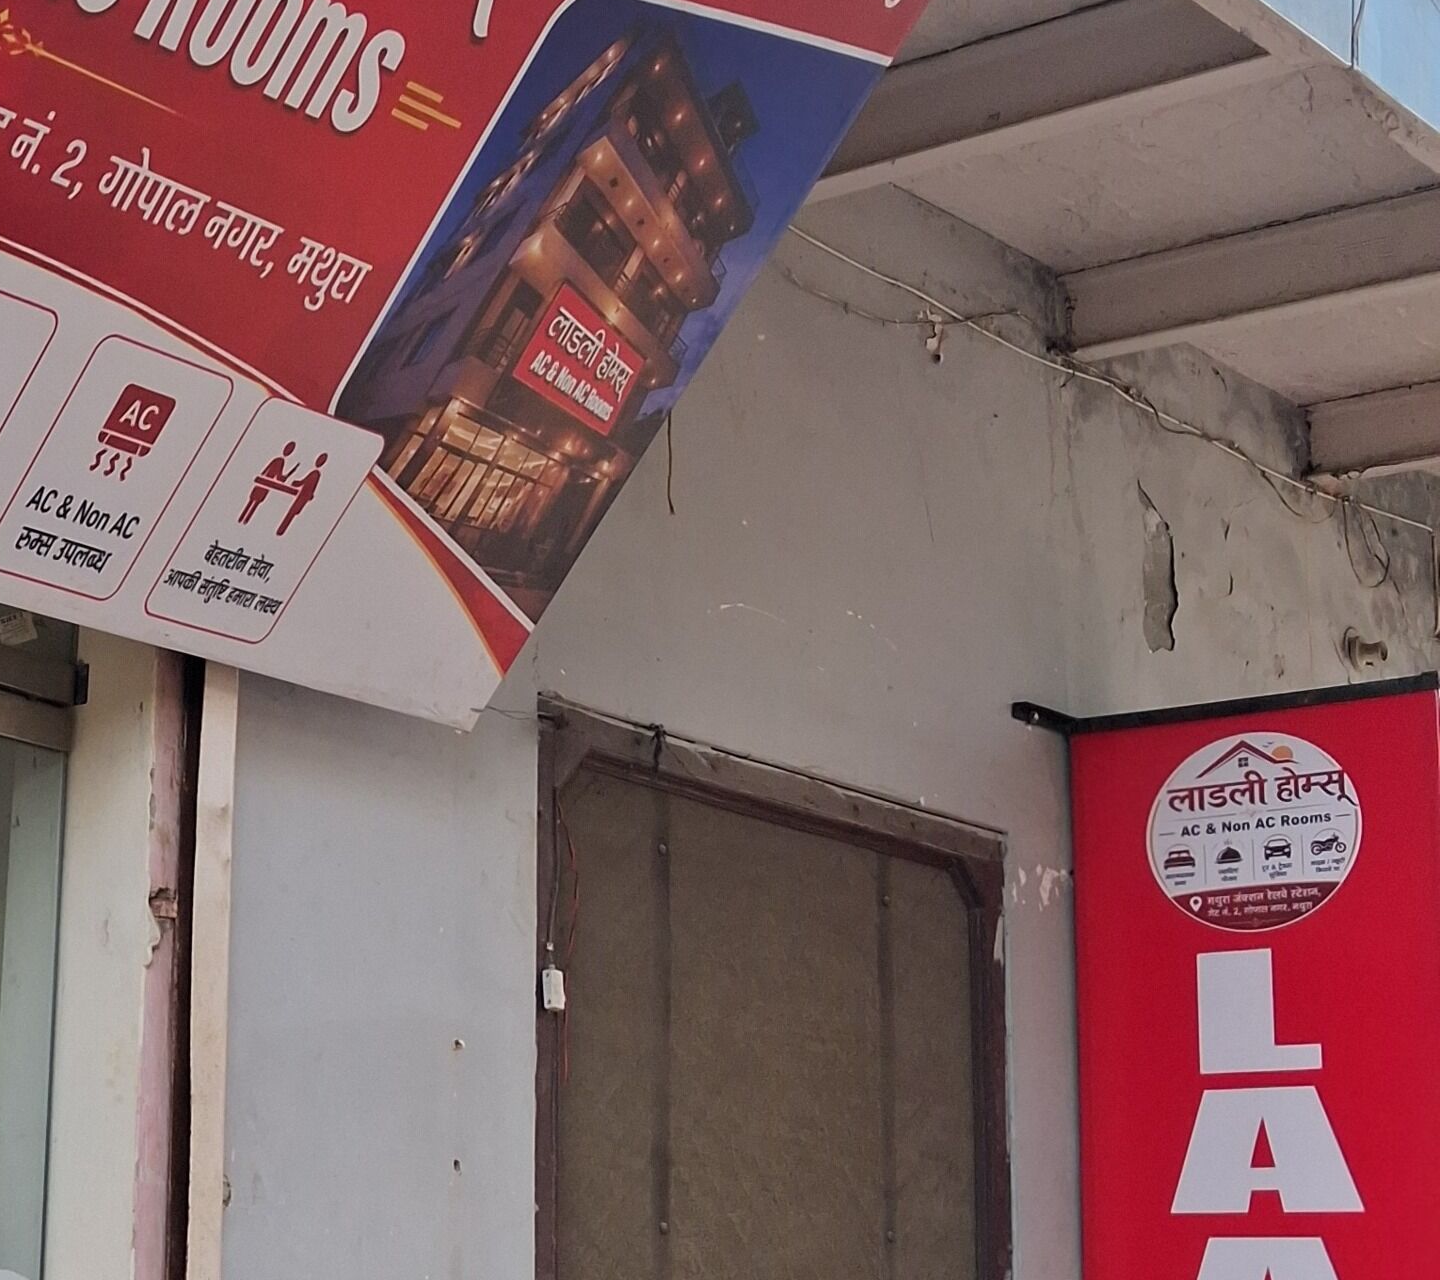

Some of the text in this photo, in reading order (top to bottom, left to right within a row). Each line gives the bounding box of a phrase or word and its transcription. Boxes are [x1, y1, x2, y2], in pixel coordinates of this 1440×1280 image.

[11, 110, 56, 175] नं.
[50, 139, 88, 200] 2,
[98, 147, 211, 236] गोपाल
[204, 201, 285, 279] नगर,
[287, 237, 373, 312] मथुरा
[548, 306, 606, 368] लाडली
[119, 400, 160, 431] AC
[26, 486, 140, 540] AC & Non AC
[53, 536, 113, 574] उपलब्ध
[204, 539, 274, 583] बेहतरीन सेवा,
[163, 568, 202, 592] आपकी
[224, 587, 258, 608] हमारा
[1167, 770, 1267, 812] लाडली
[1181, 812, 1331, 838] AC & Non AC Rooms
